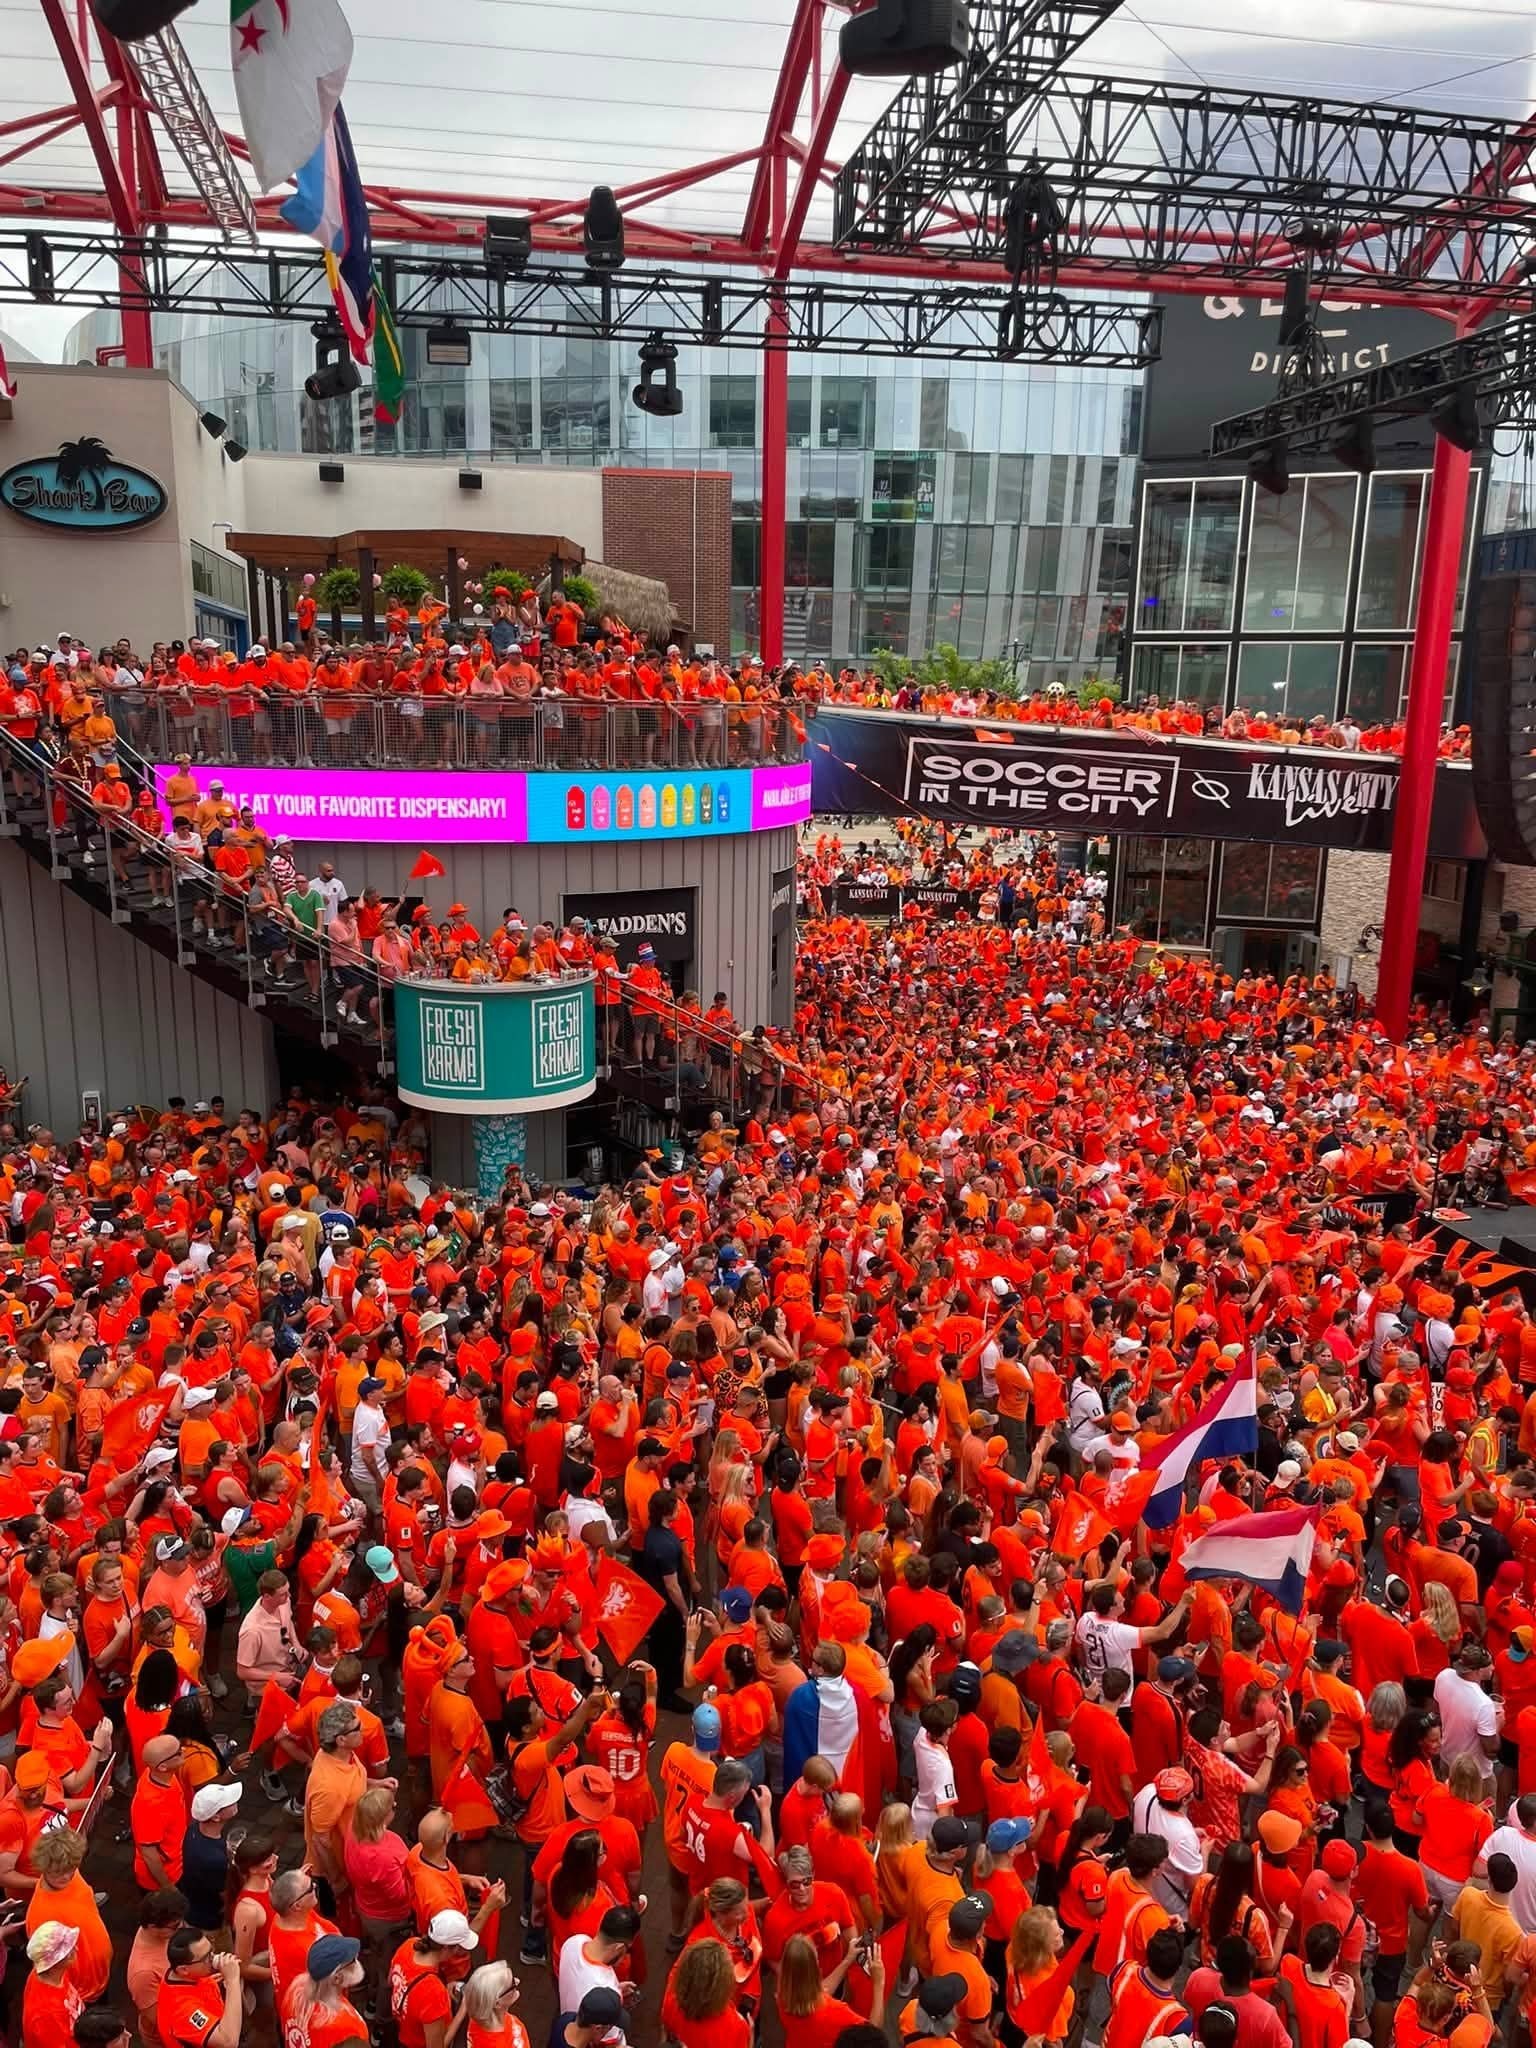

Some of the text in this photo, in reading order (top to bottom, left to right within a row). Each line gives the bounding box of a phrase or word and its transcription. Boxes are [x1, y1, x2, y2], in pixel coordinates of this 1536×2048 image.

[12, 476, 160, 513] Shark Bar
[922, 755, 1161, 794] SOCCER
[1247, 763, 1401, 811] KANSAS CITY
[252, 793, 270, 815] AT
[271, 794, 316, 817] YOUR
[319, 795, 396, 819] FAVORITE
[401, 797, 507, 819] DISPENSARY!
[919, 783, 1159, 816] IN THE CITY
[593, 911, 687, 936] FADDEN'S
[426, 1006, 476, 1046] FRESH
[539, 1000, 579, 1042] FRESH
[427, 1044, 477, 1084] KARMA
[540, 1037, 580, 1079] KARMA
[607, 1748, 640, 1781] 10
